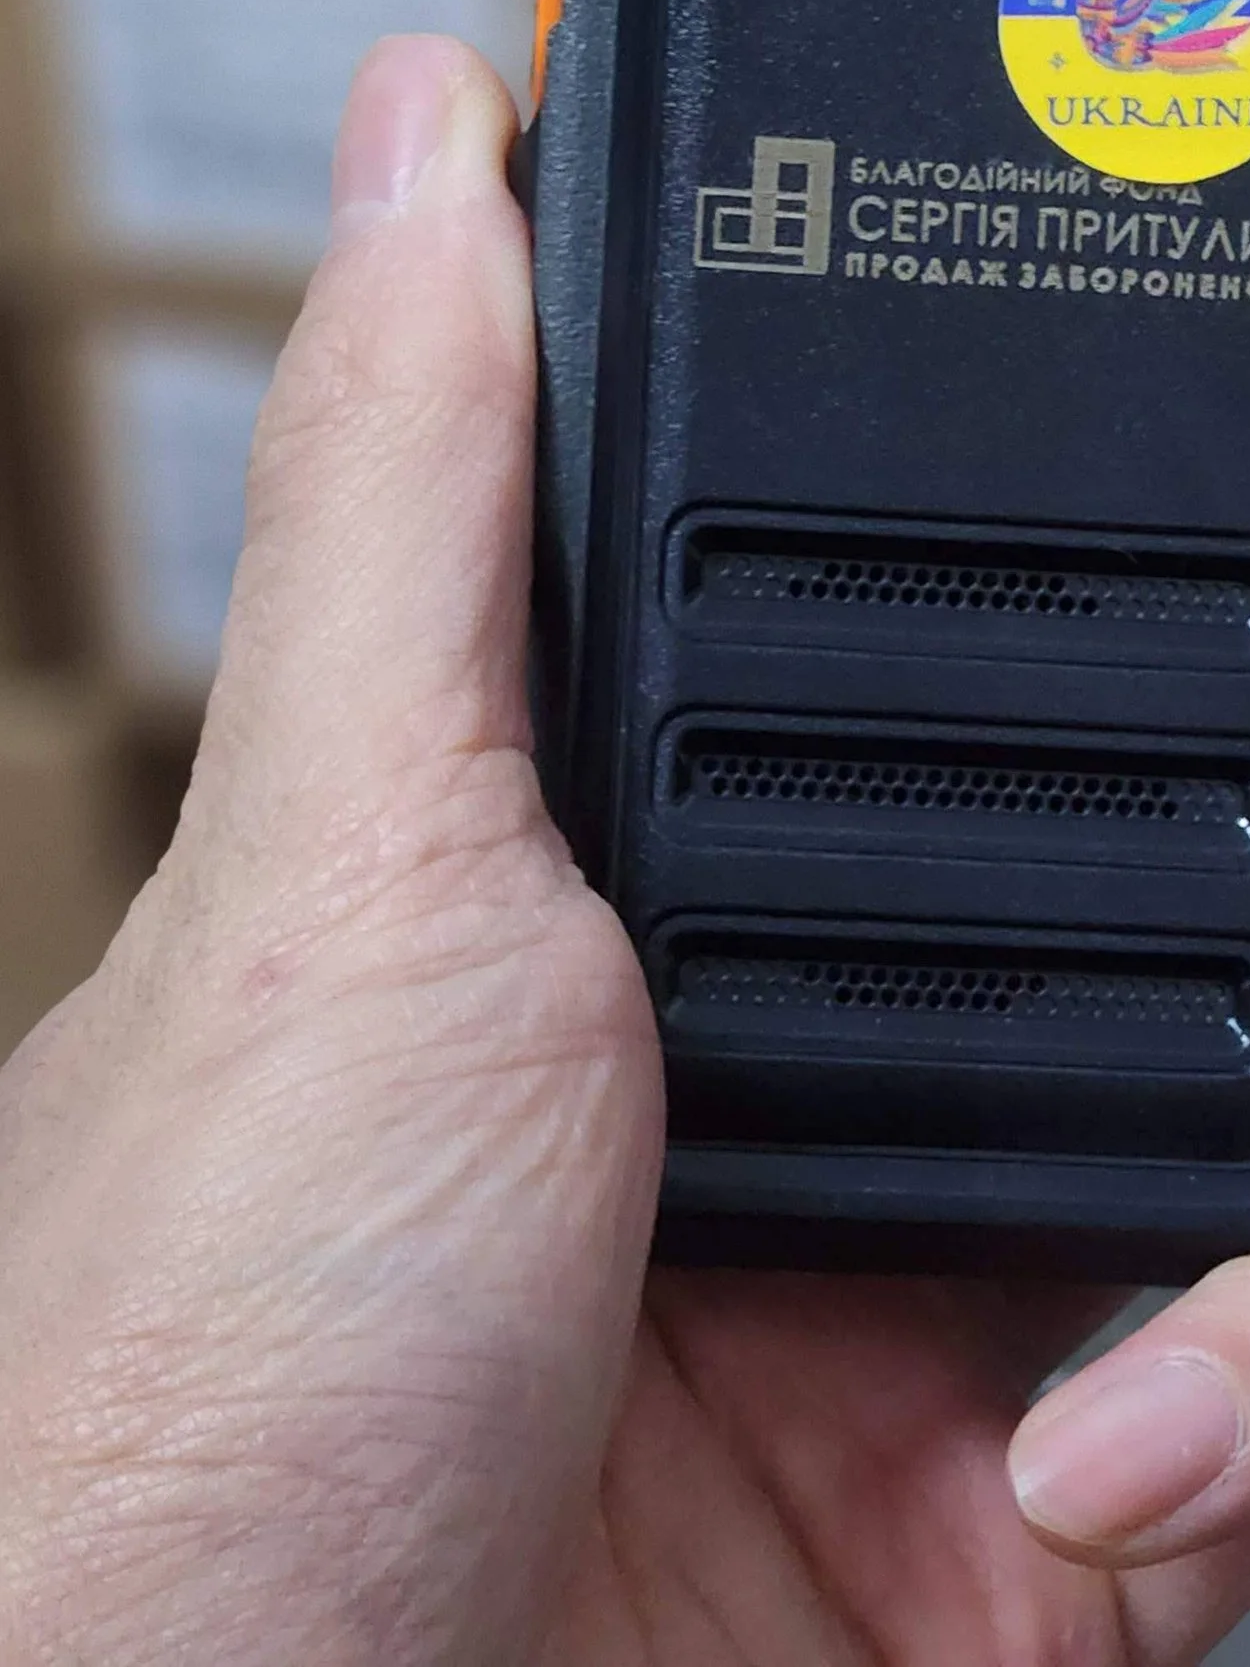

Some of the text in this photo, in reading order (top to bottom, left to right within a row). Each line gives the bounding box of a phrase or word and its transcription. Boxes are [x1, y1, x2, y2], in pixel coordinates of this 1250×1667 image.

[850, 156, 1091, 197] БЛАГОДІЙНИЙ
[849, 194, 1019, 249] СЕРГІЯ
[844, 251, 1008, 286] ПРОДАЖ
